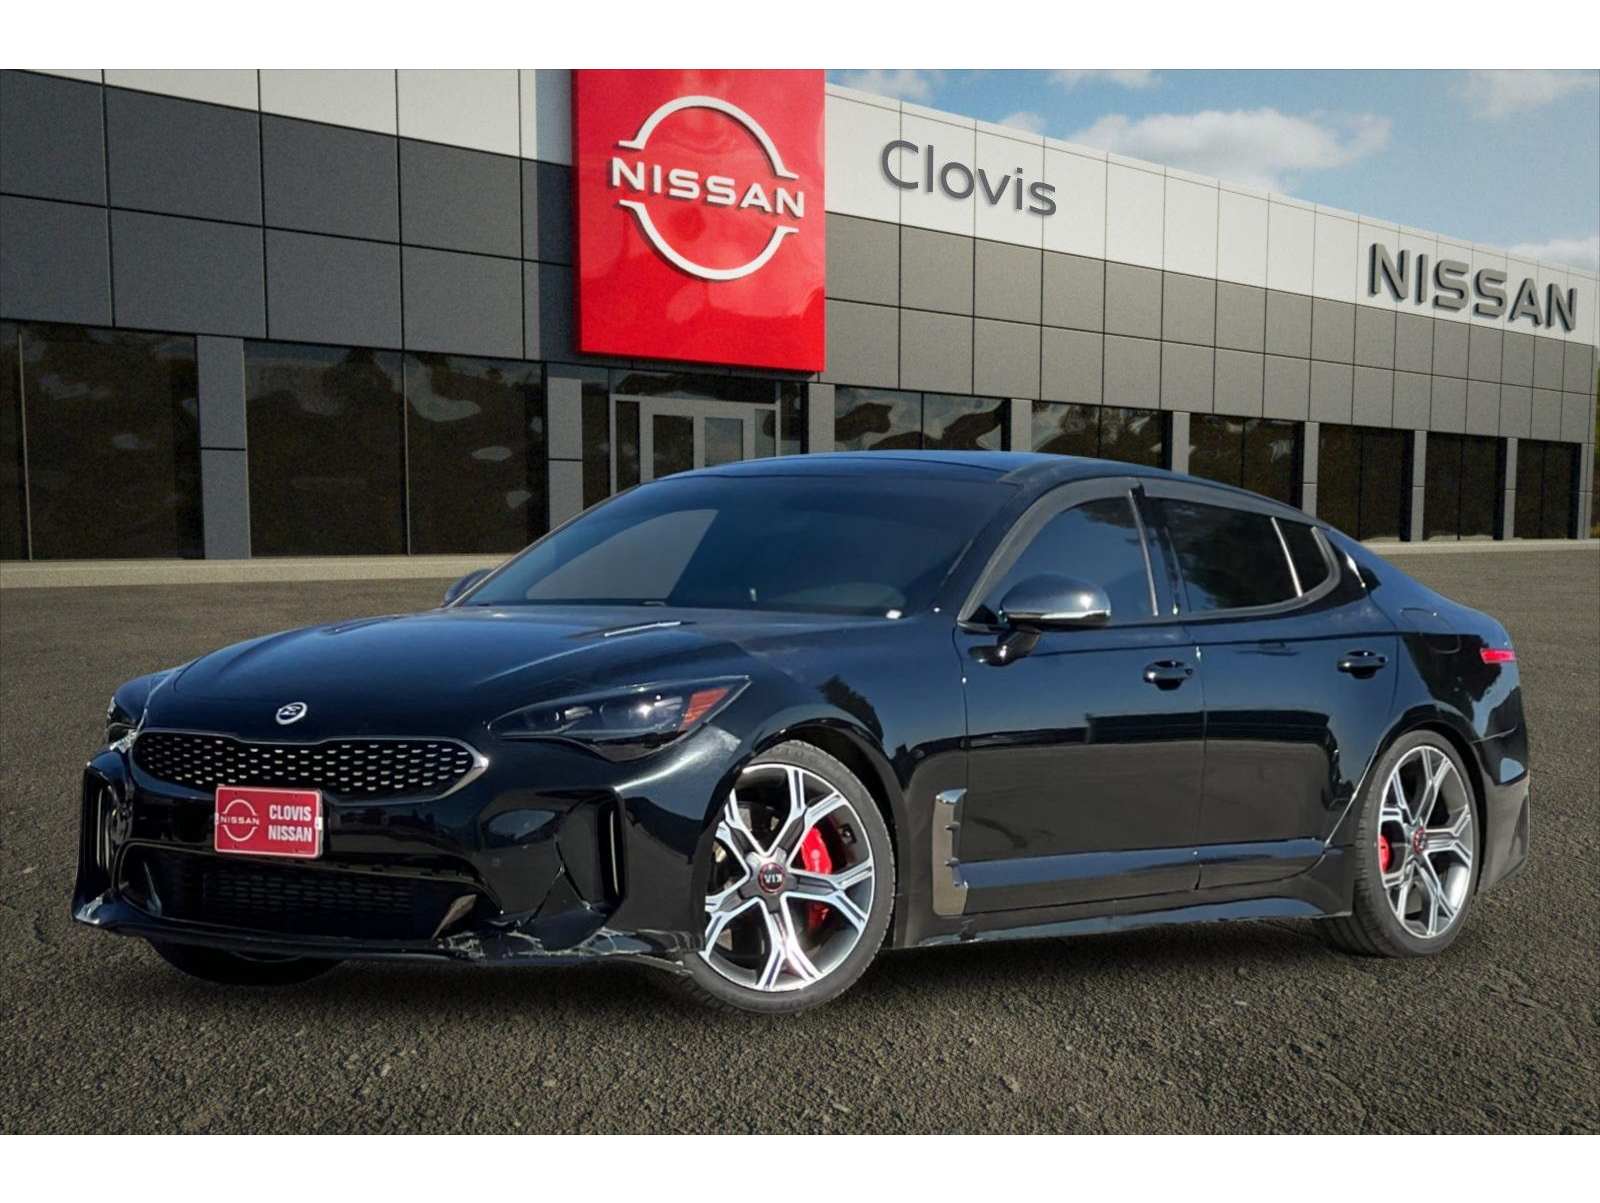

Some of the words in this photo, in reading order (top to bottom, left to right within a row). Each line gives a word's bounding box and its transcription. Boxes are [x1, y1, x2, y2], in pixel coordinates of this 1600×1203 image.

[611, 157, 804, 218] NISSAN
[881, 140, 1057, 216] Clovis
[1369, 243, 1578, 331] NISSAN
[221, 816, 260, 825] NISSAN
[269, 805, 312, 821] CLOVIS
[268, 825, 313, 842] NISSAN
